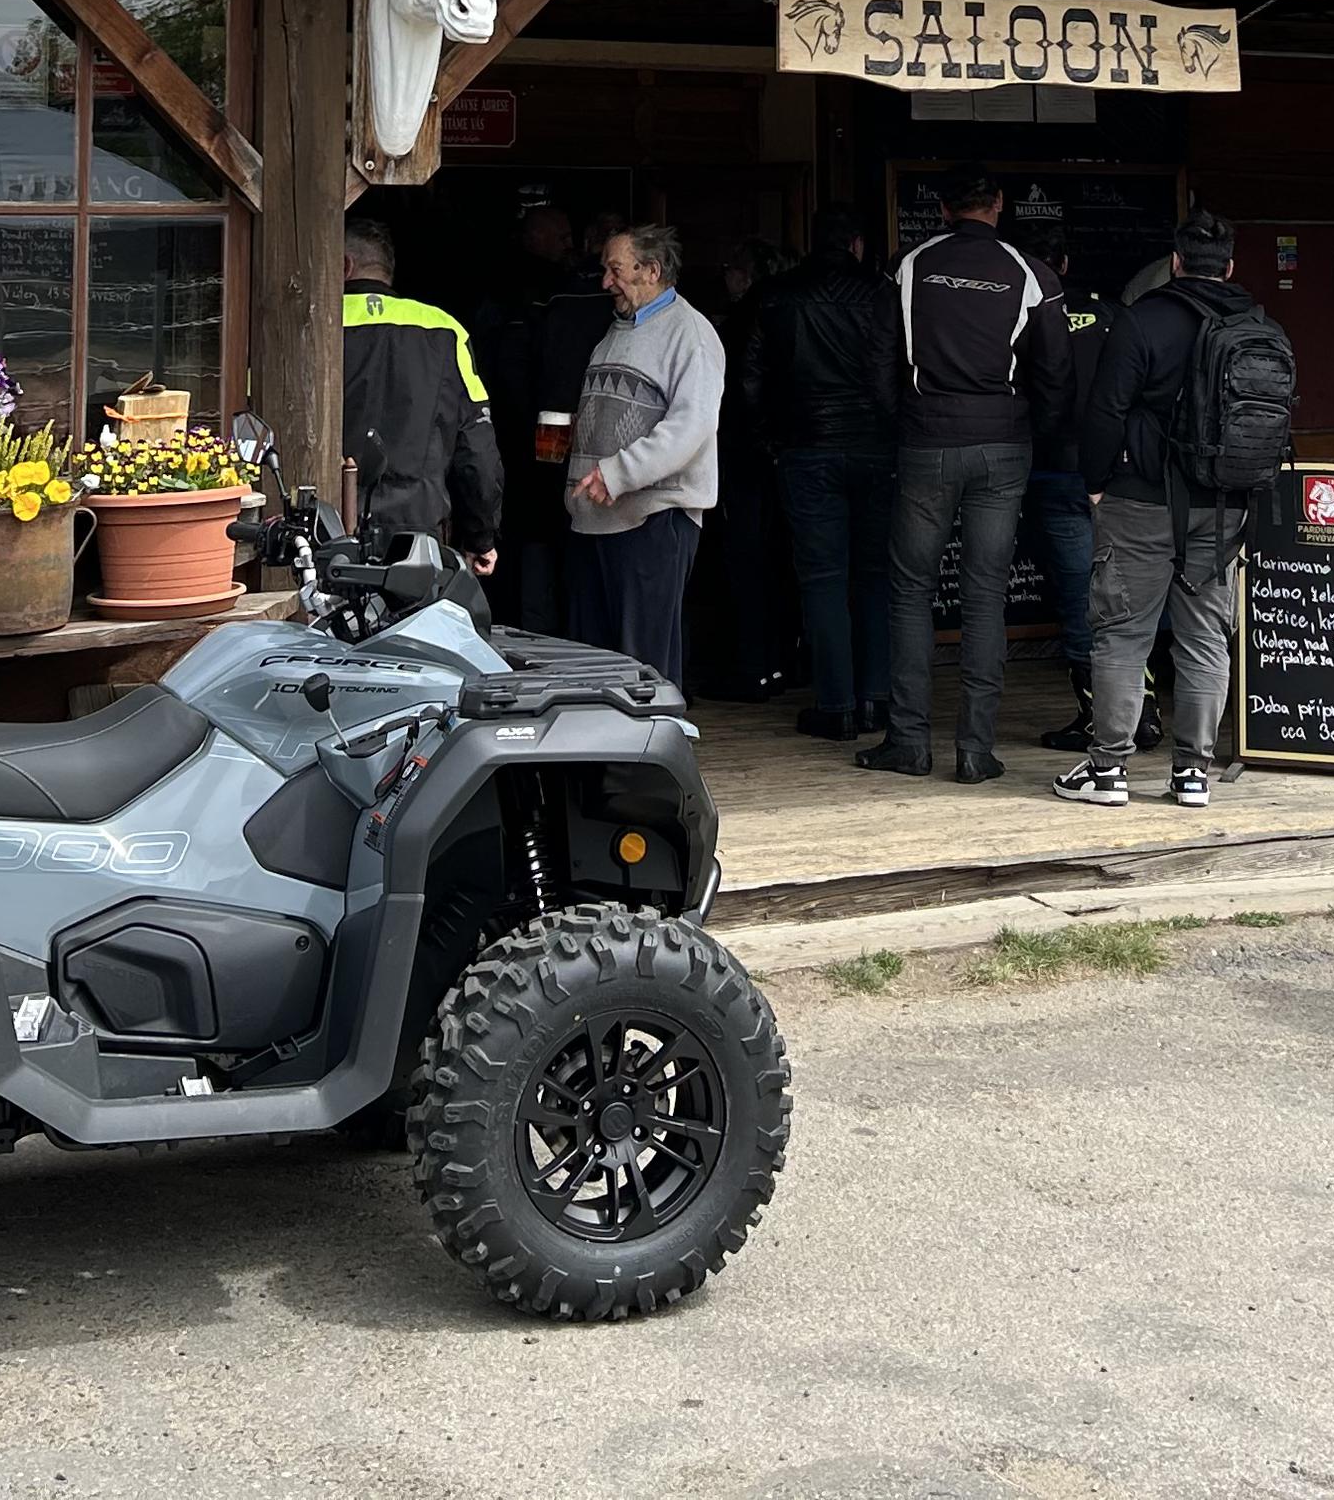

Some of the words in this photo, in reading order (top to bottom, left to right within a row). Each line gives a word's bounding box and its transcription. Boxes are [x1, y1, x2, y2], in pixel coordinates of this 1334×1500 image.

[1014, 205, 1063, 218] MUSTANG
[1303, 635, 1329, 652] nad
[259, 654, 424, 674] CFORCE
[337, 686, 401, 695] TOURING
[1248, 694, 1291, 717] Doba
[1280, 725, 1307, 741] cca
